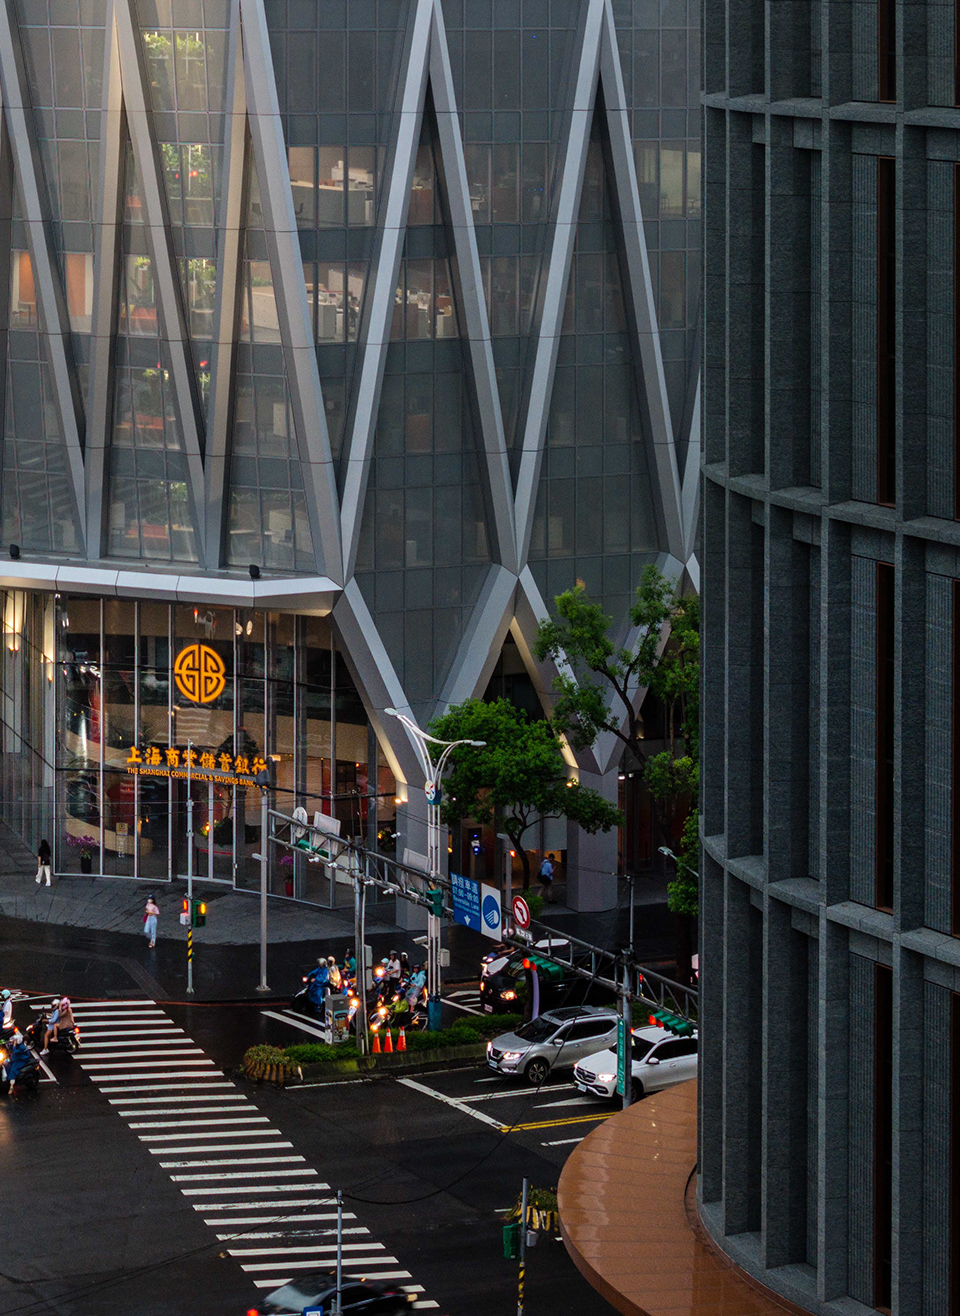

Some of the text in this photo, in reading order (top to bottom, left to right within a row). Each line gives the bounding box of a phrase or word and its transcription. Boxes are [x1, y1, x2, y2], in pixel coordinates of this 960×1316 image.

[126, 746, 268, 776] 上海商業儲蓄銀行
[139, 768, 170, 777] SHANGHAI
[214, 775, 239, 785] SAVINGS
